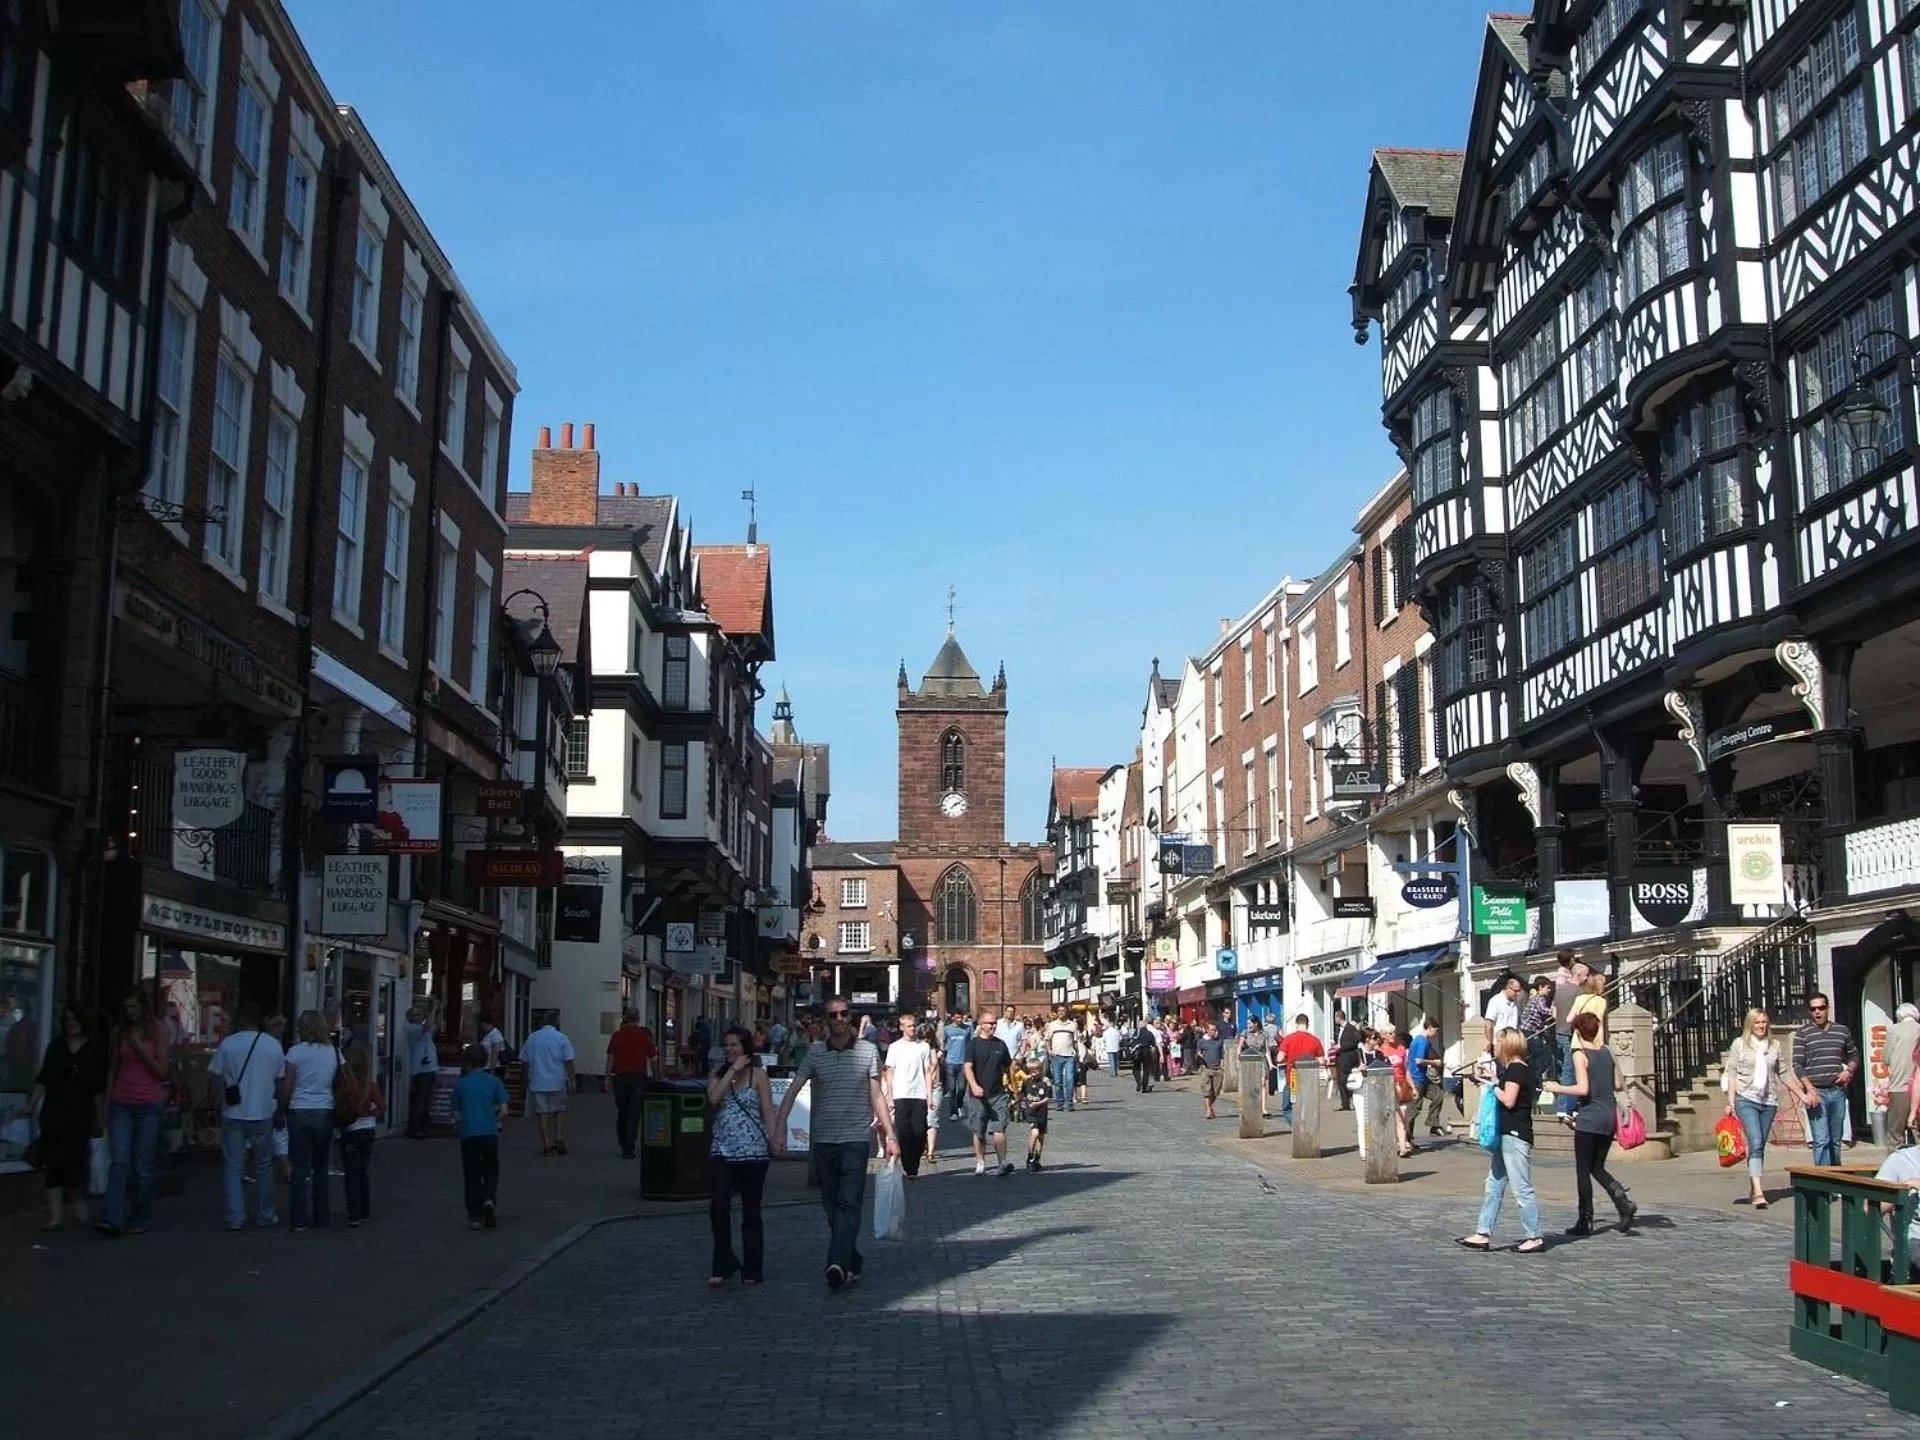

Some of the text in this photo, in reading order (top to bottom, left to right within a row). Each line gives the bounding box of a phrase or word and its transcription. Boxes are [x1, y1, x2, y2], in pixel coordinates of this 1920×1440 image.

[1748, 724, 1773, 738] Centre
[184, 756, 236, 769] LEATHER
[191, 768, 228, 779] GOODS
[180, 781, 237, 793] HANDBAGS
[184, 796, 233, 808] LUGGAGE
[488, 800, 512, 809] Bell
[1737, 833, 1772, 845] urchin
[328, 861, 382, 873] LEATHER
[491, 862, 537, 873] NICOLAS
[335, 874, 375, 885] GOODS
[327, 887, 384, 898] HANDBAGS
[1638, 883, 1689, 899] BOSS
[332, 901, 377, 913] LUGGAGE
[564, 905, 591, 919] South
[1250, 910, 1281, 921] lakeland
